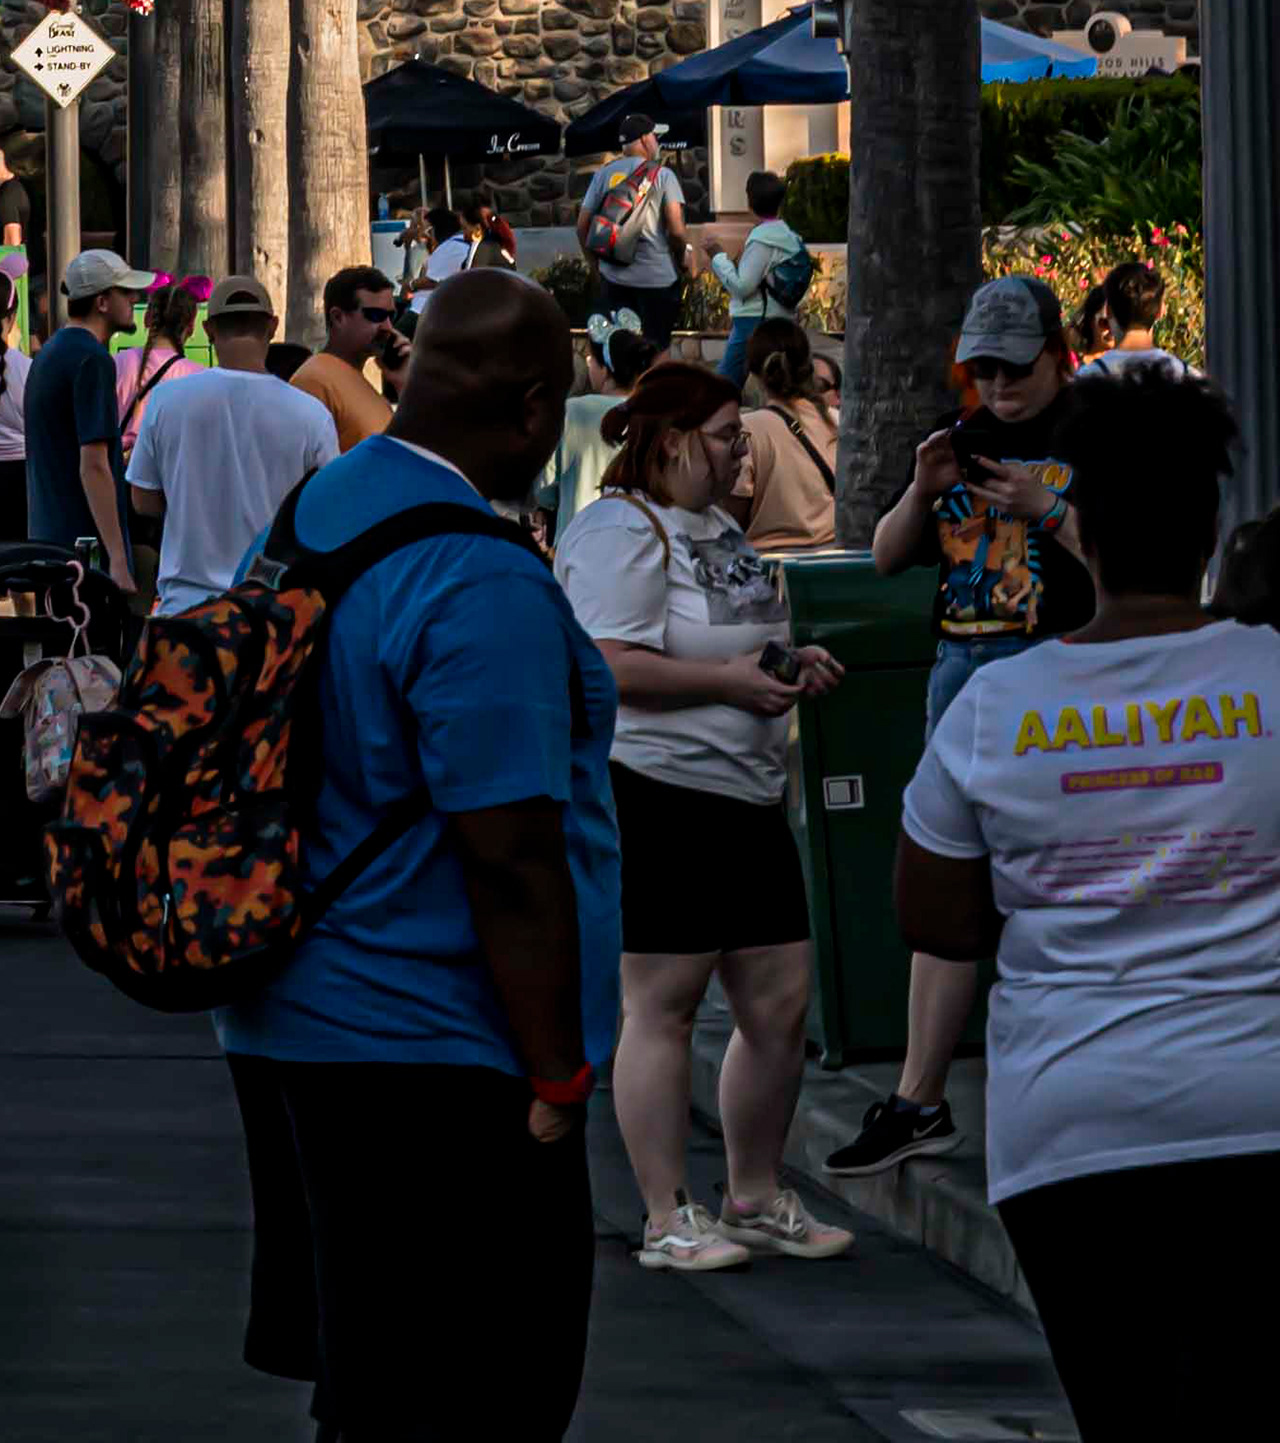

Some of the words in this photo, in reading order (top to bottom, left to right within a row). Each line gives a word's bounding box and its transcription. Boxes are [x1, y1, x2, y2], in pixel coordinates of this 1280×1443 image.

[46, 43, 95, 54] LIGHTNING
[46, 62, 91, 71] STAND-BY
[1014, 692, 1263, 757] AALIYAH
